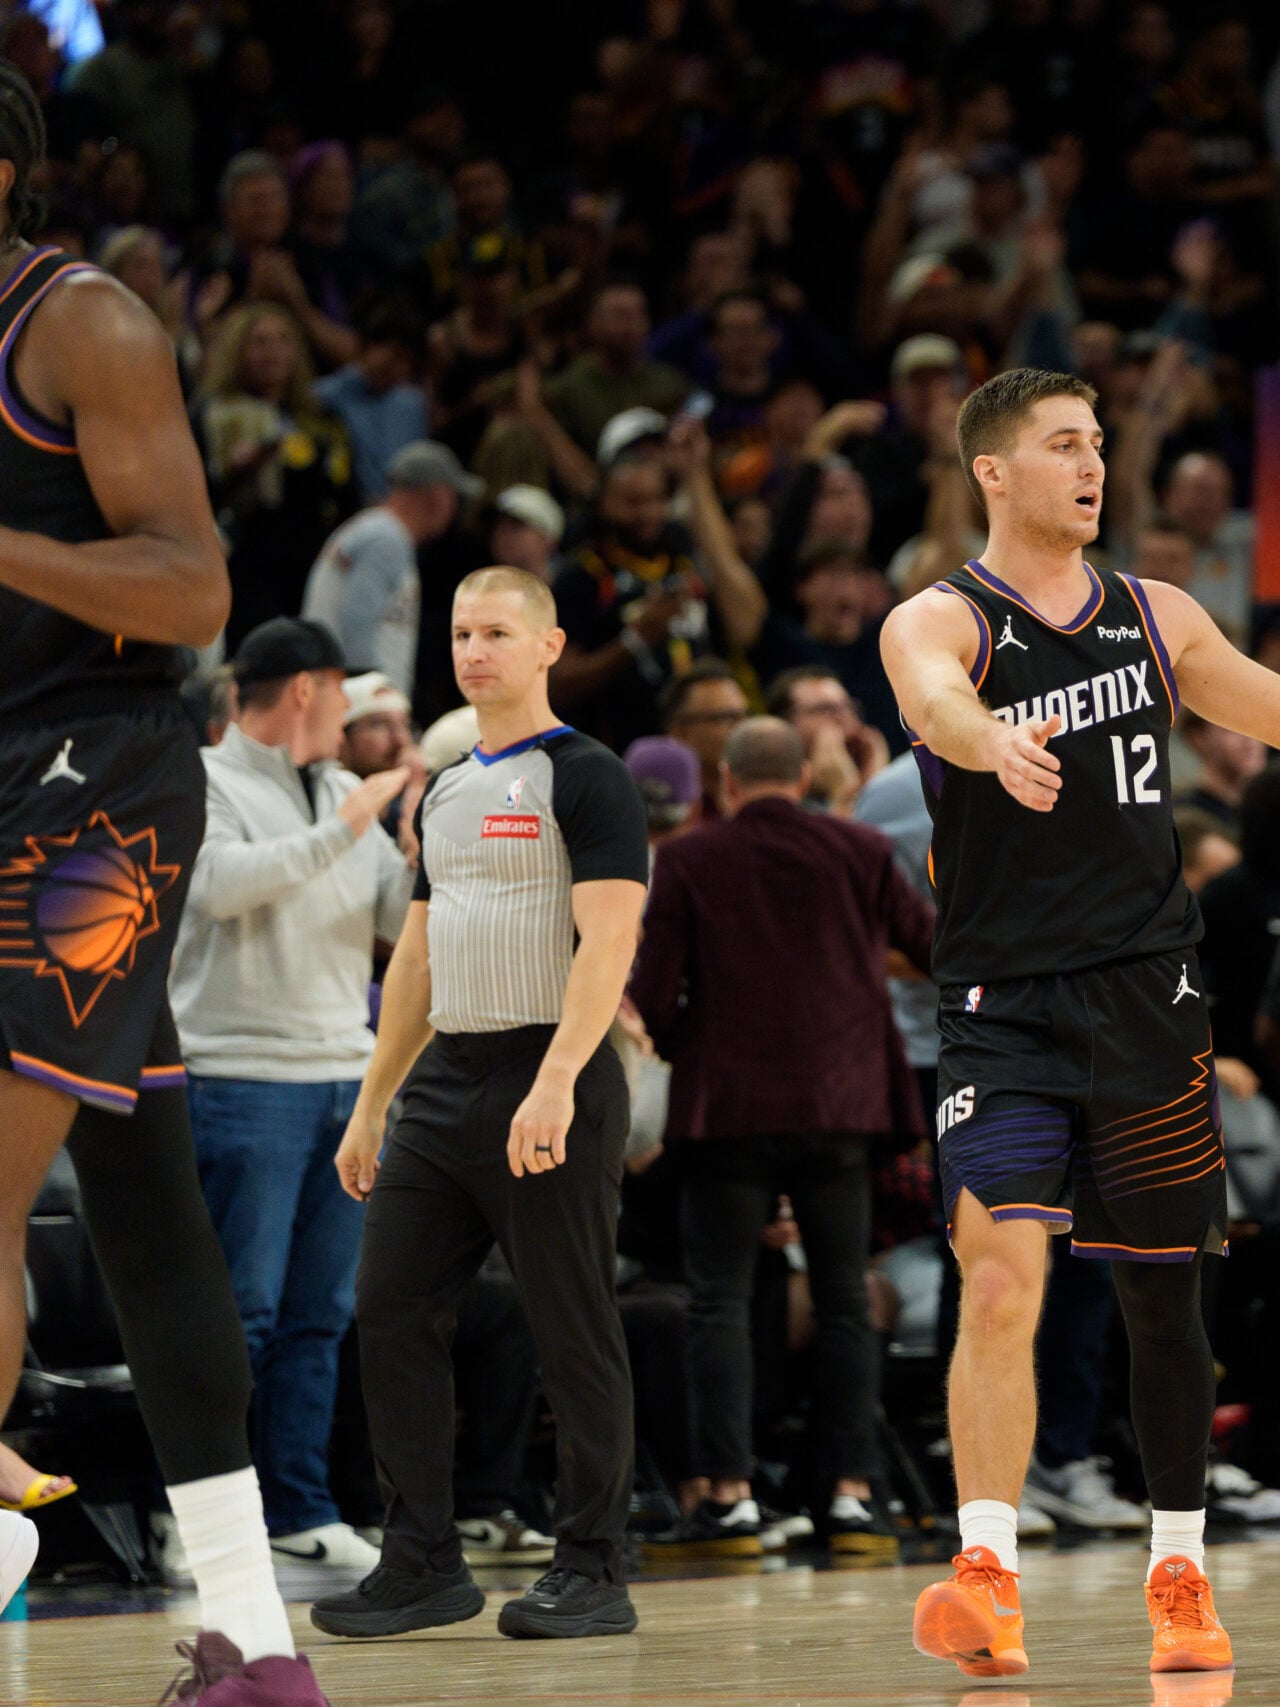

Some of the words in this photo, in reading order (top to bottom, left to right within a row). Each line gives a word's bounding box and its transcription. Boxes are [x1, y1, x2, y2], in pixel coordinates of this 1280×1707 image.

[1097, 625, 1142, 642] PayPal
[991, 659, 1155, 738] HOENIX
[1109, 734, 1161, 804] 12
[483, 818, 538, 834] Emirates
